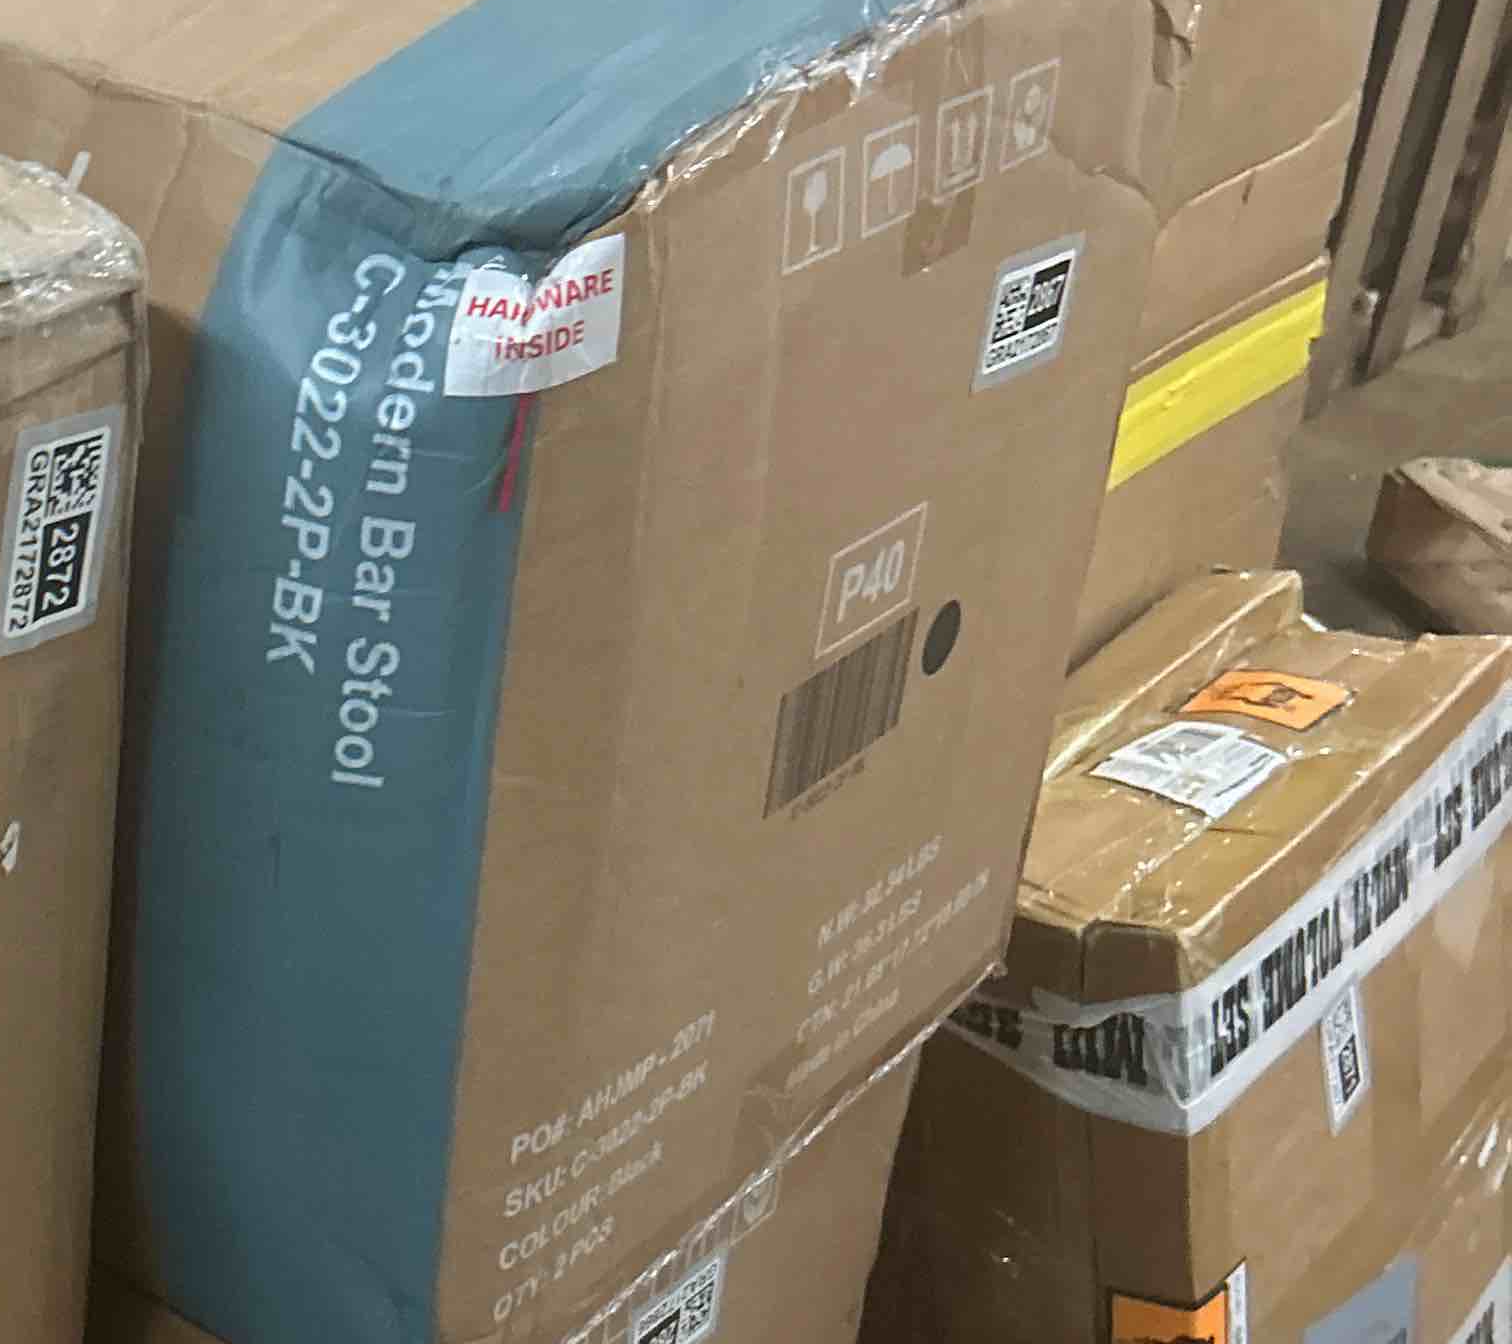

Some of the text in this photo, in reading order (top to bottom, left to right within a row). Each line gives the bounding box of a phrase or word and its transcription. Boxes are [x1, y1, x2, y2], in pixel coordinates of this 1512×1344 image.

[494, 319, 586, 362] INSIDE
[265, 252, 407, 675] C-3022-2P-BK
[8, 450, 50, 633] GRA2172872
[42, 521, 81, 611] 2872
[329, 260, 472, 789] Modern Bar Stool
[836, 539, 906, 624] P40
[1210, 973, 1252, 1079] SET
